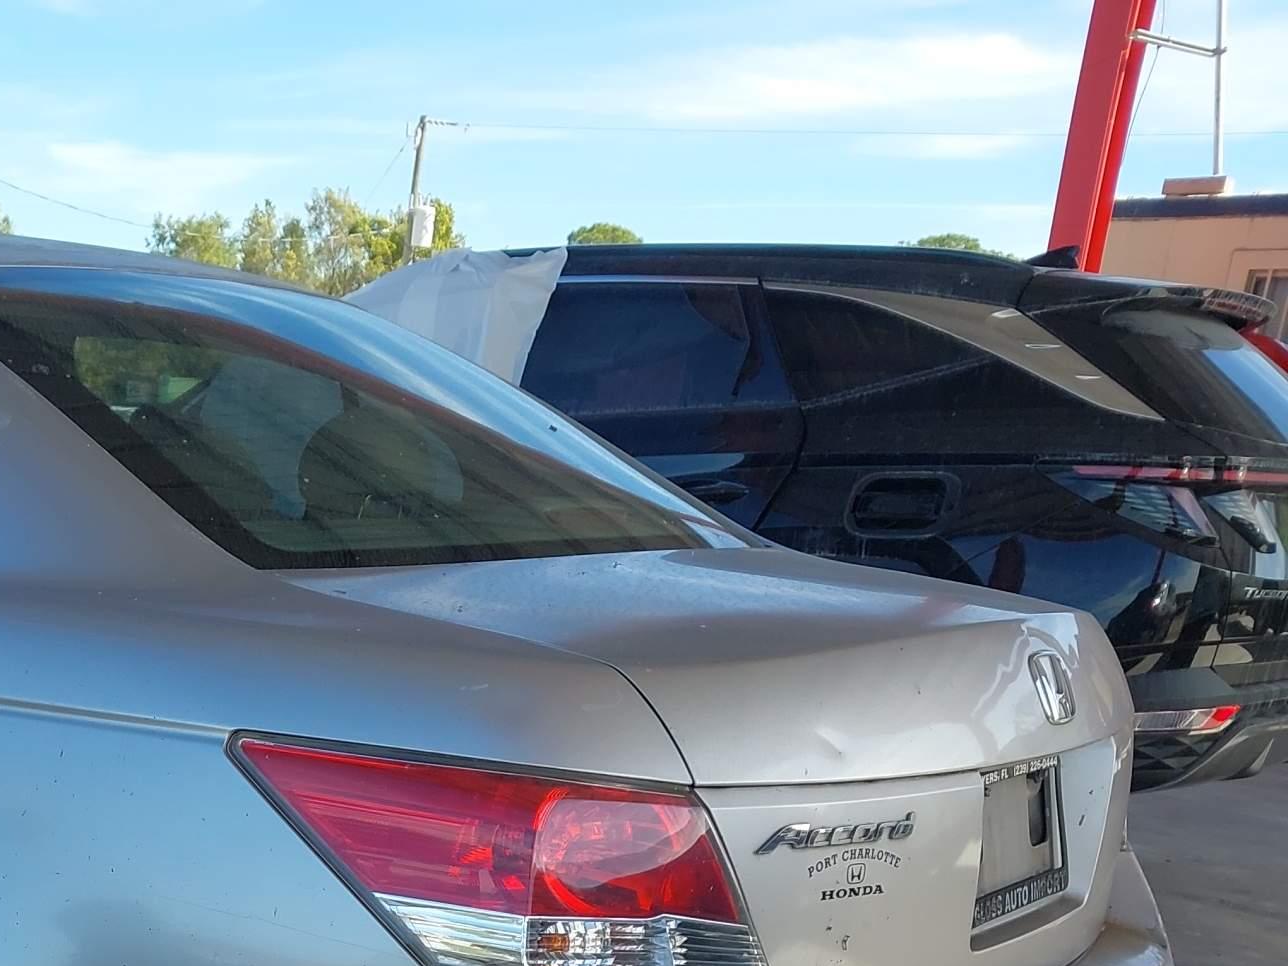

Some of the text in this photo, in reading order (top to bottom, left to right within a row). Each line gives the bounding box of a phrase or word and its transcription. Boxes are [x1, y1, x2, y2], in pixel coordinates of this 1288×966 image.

[1001, 767, 1009, 780] FL
[1013, 762, 1029, 777] (239)
[753, 811, 915, 854] Accord
[807, 848, 902, 878] PORT CHARLOTTE
[820, 884, 884, 901] HONDA
[1004, 884, 1029, 913] AUTO
